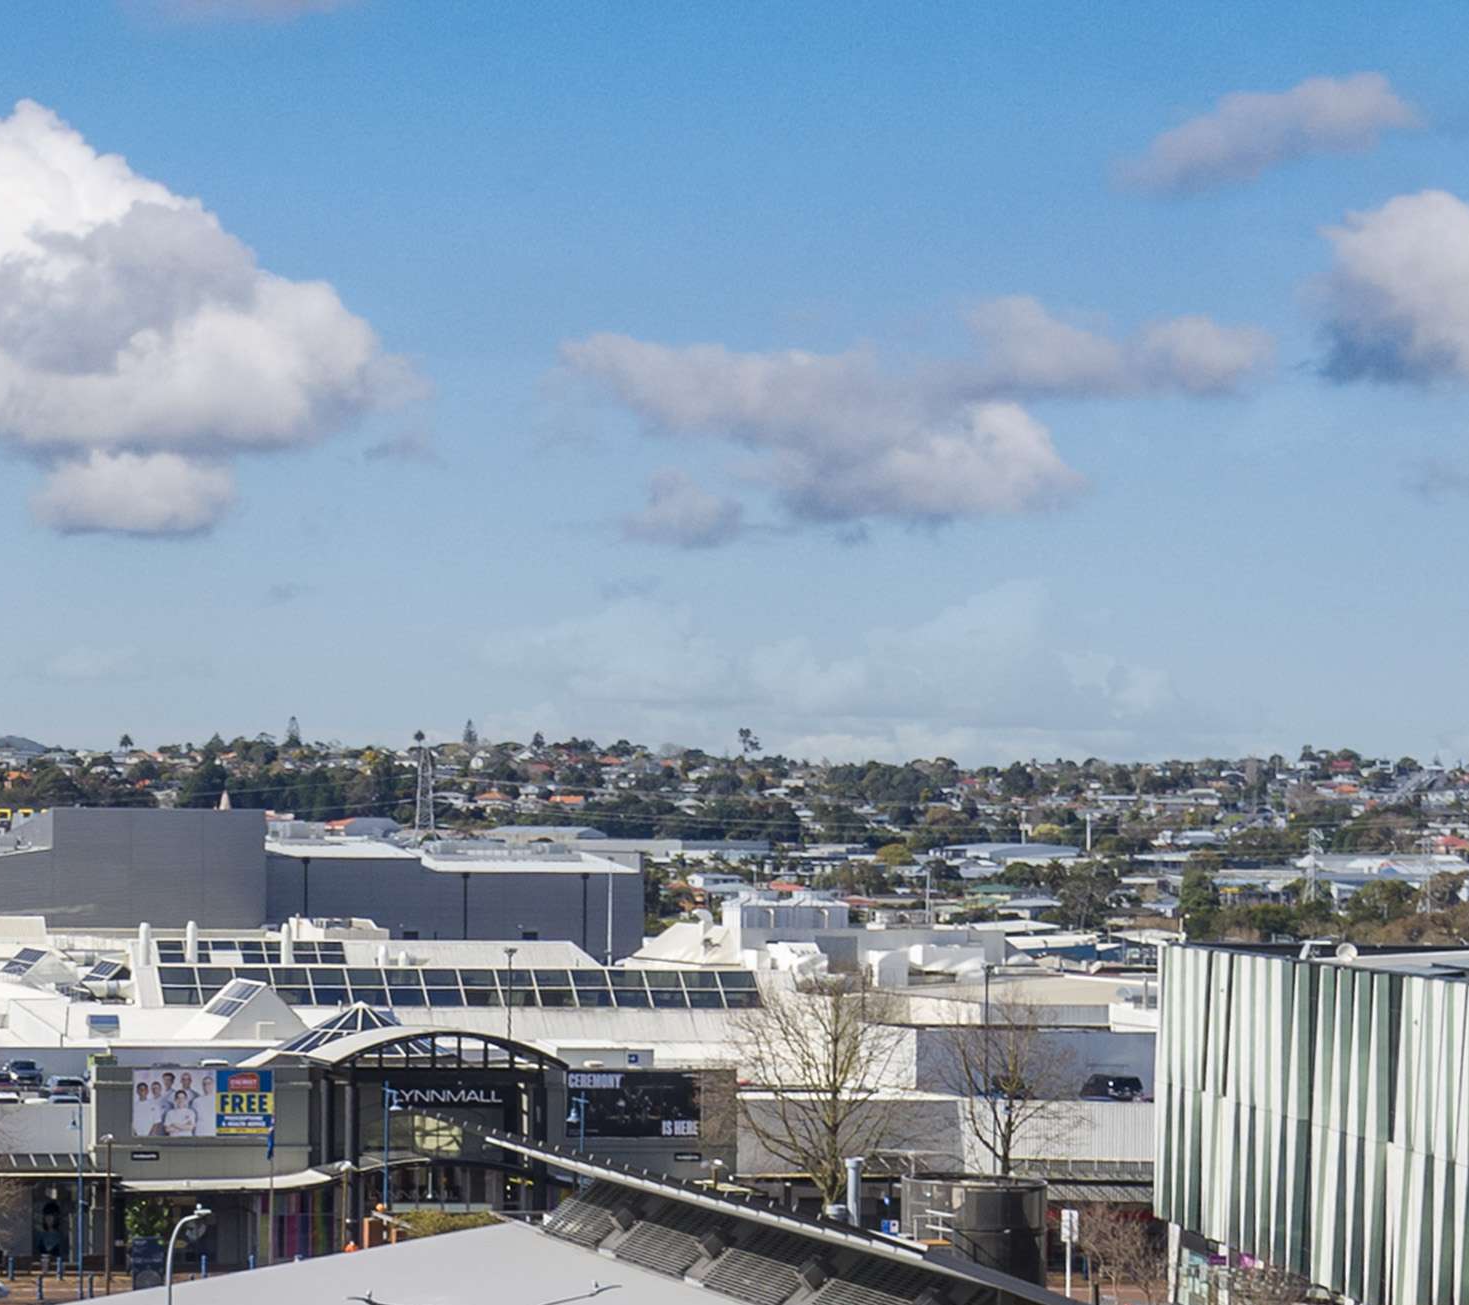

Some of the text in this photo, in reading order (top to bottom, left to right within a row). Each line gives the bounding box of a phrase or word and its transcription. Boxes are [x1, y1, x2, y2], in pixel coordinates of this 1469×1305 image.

[568, 1073, 622, 1089] CEREMONY
[220, 1094, 268, 1112] FREE
[662, 1120, 699, 1135] IS HERE
